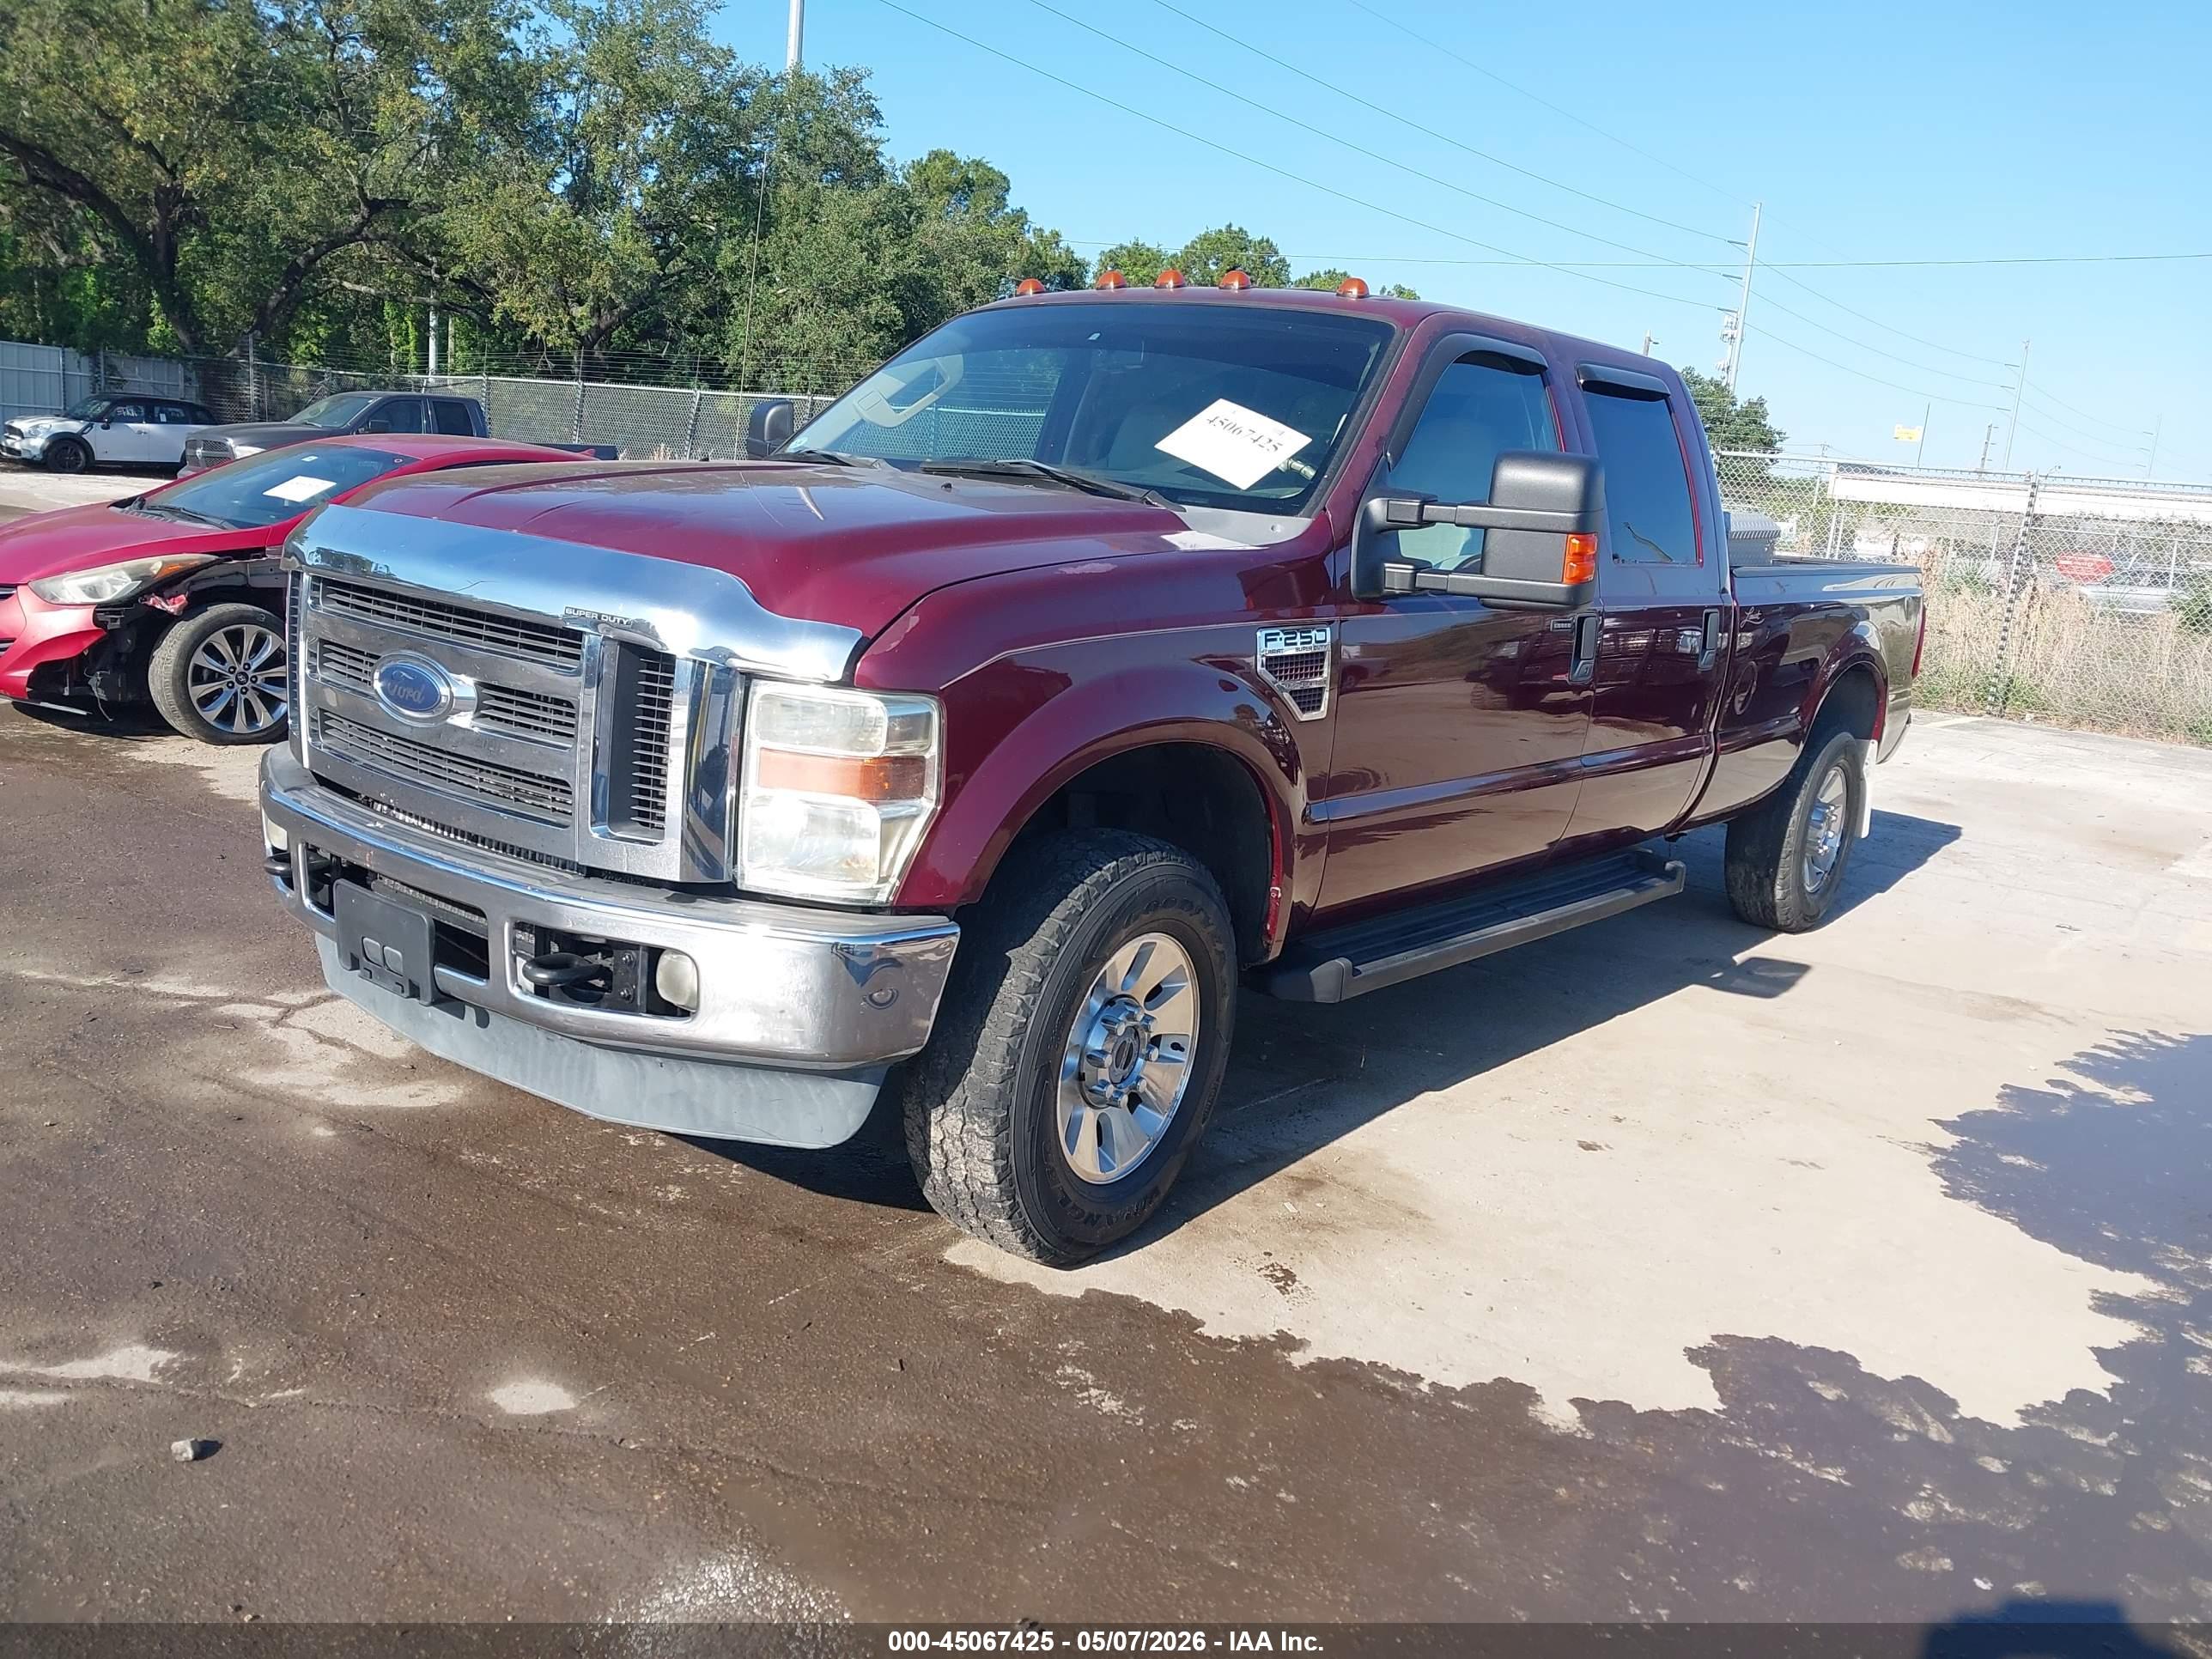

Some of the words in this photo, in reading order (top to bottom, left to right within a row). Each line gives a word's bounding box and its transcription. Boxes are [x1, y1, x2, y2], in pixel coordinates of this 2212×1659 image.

[1206, 416, 1283, 452] 45067425
[565, 608, 599, 619] SUPER
[601, 614, 630, 625] DUTY
[386, 669, 426, 703] Ford
